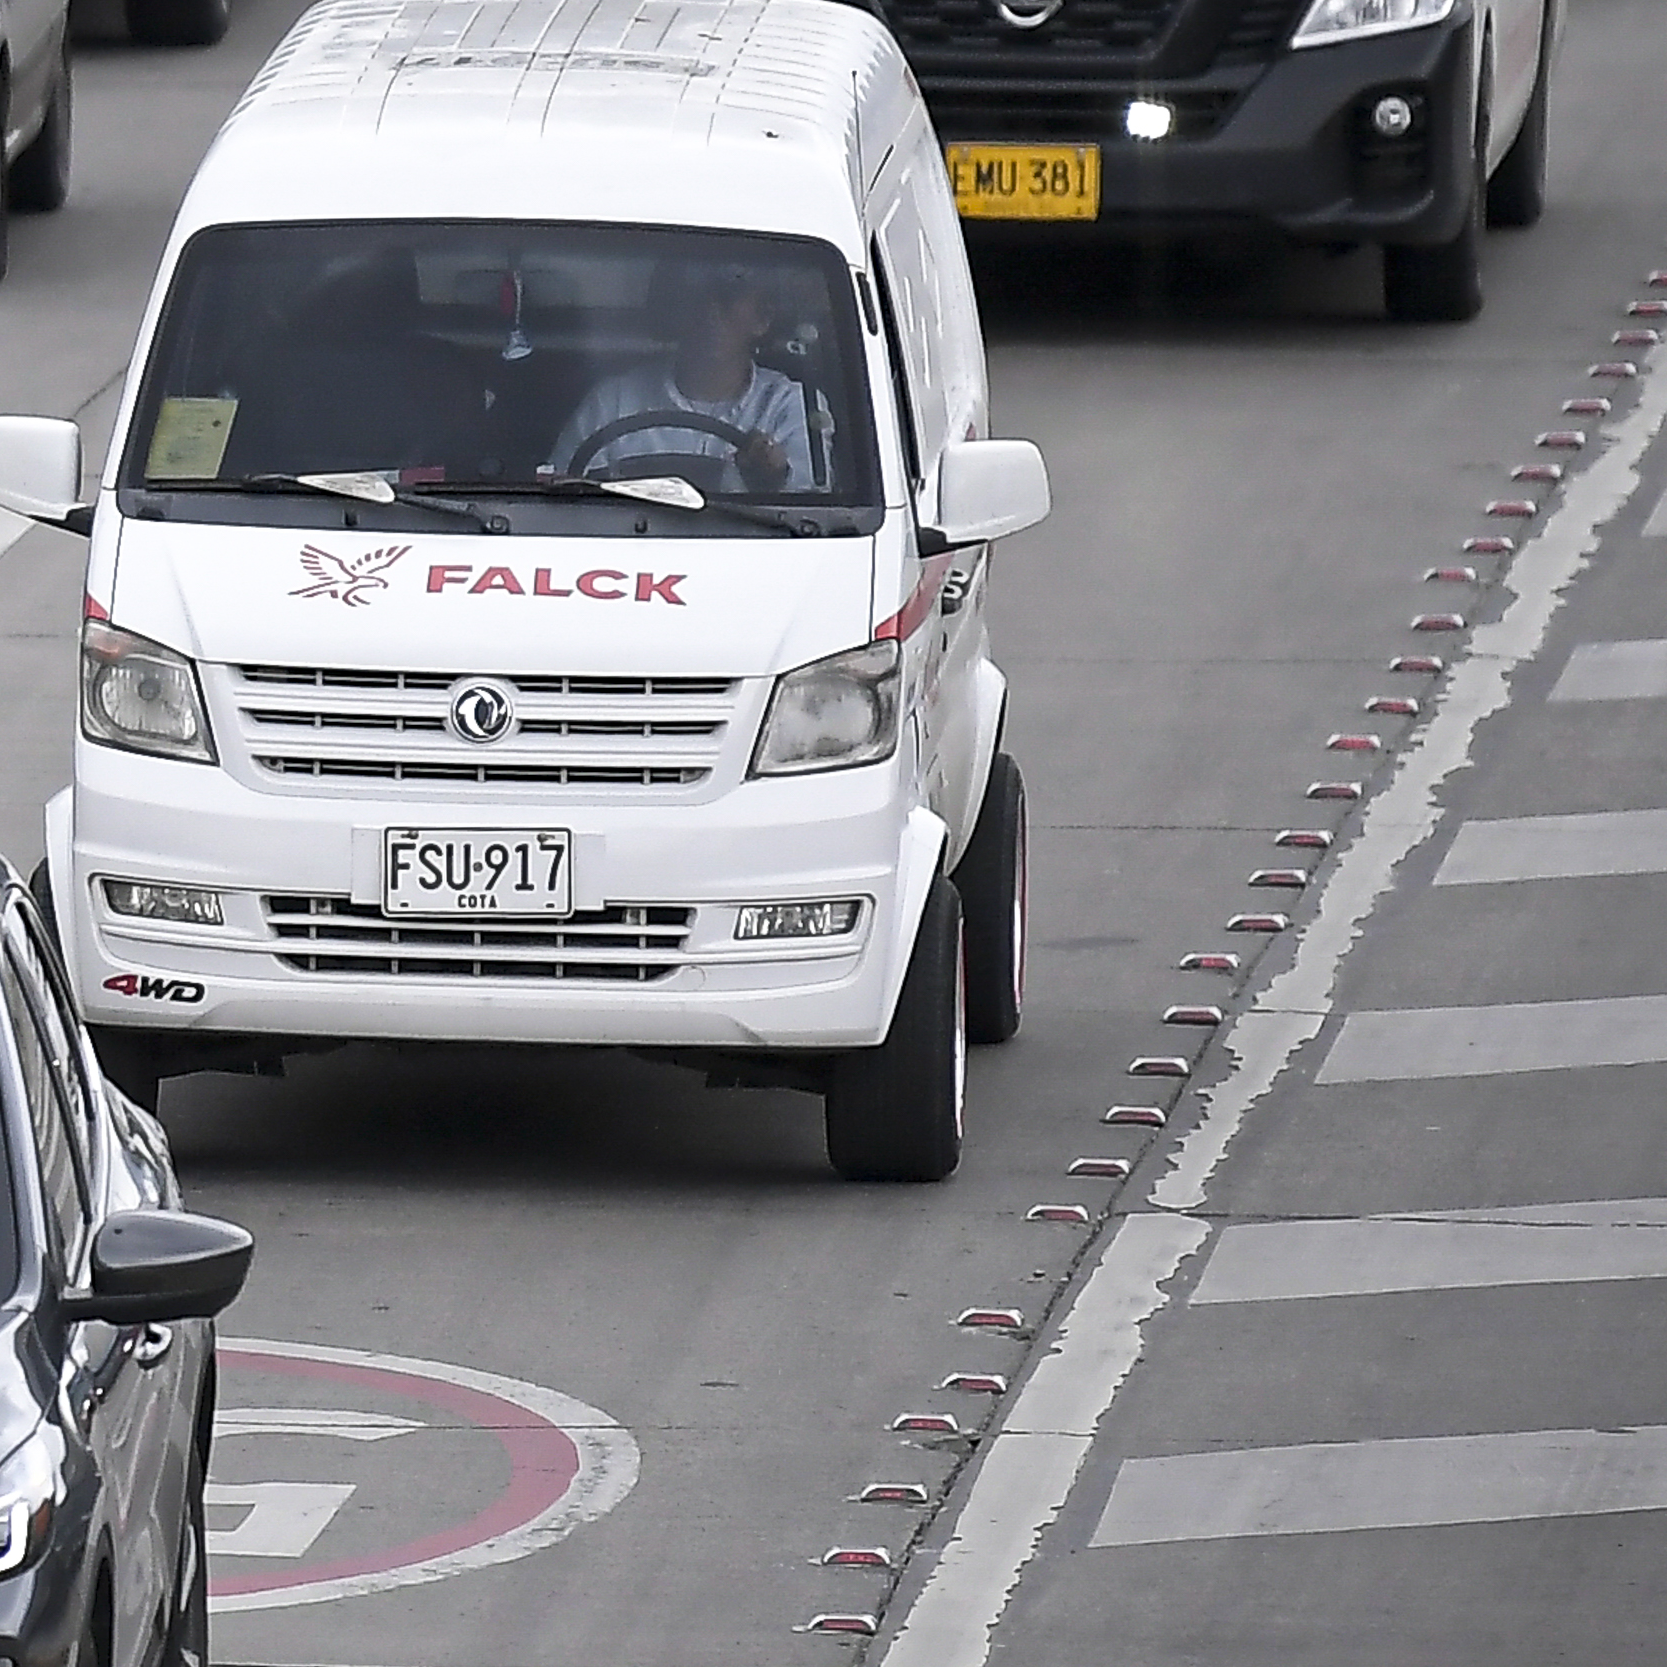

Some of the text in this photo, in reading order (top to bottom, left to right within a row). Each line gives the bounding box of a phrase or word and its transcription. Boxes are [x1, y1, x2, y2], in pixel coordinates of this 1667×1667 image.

[952, 156, 1087, 198] EMU 381
[426, 564, 688, 606] FALCK
[457, 894, 498, 909] COTA
[102, 974, 206, 1004] 4WD
